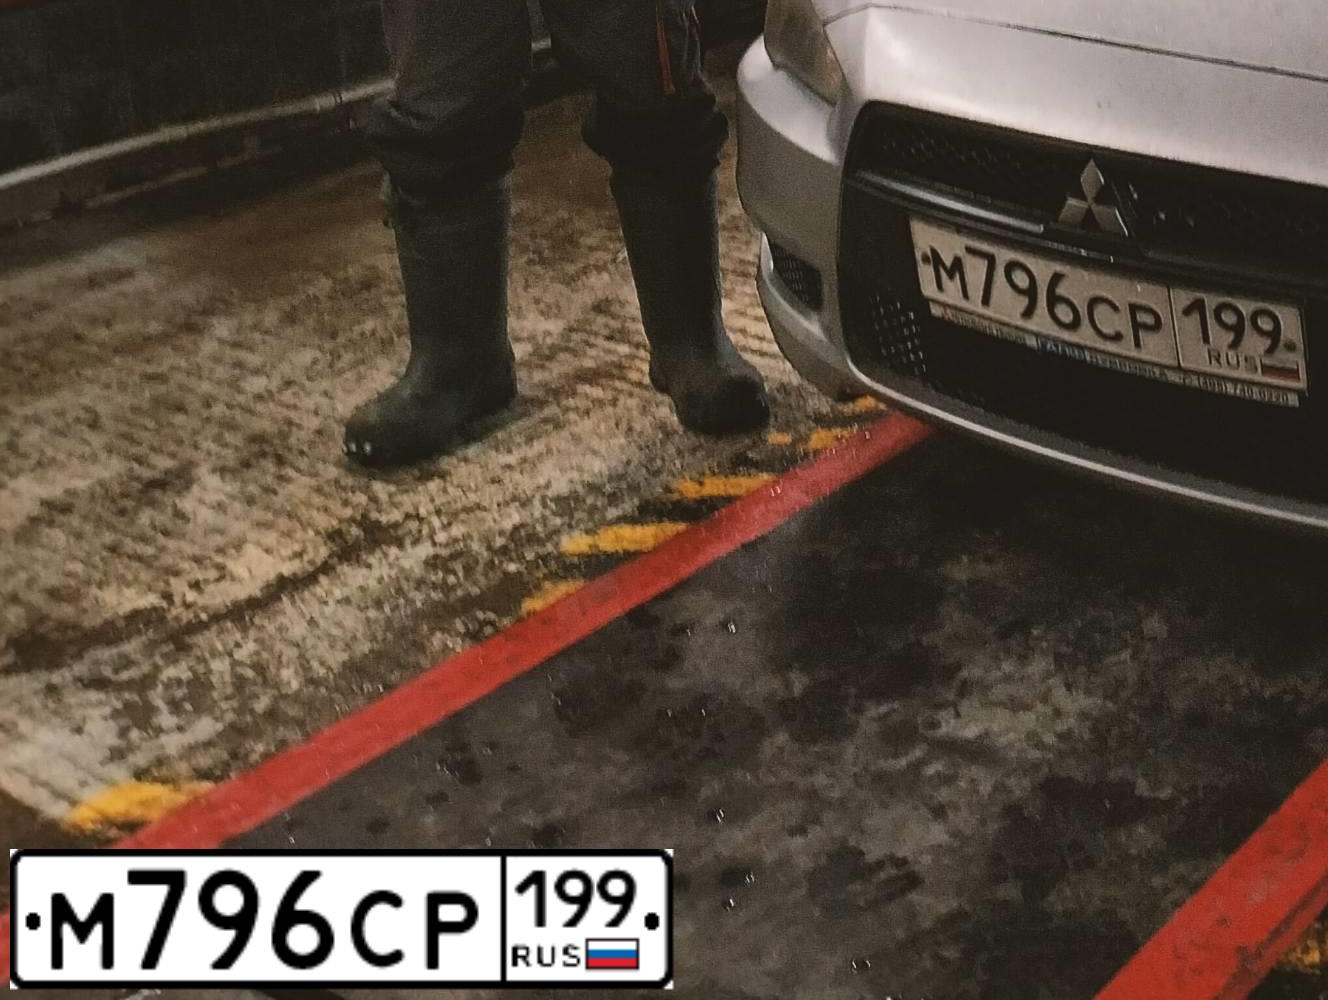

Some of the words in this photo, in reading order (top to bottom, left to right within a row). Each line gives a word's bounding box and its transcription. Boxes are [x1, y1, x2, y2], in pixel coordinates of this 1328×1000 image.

[929, 245, 1163, 350] М796СР
[1182, 296, 1282, 355] 199
[1207, 347, 1259, 374] RUS
